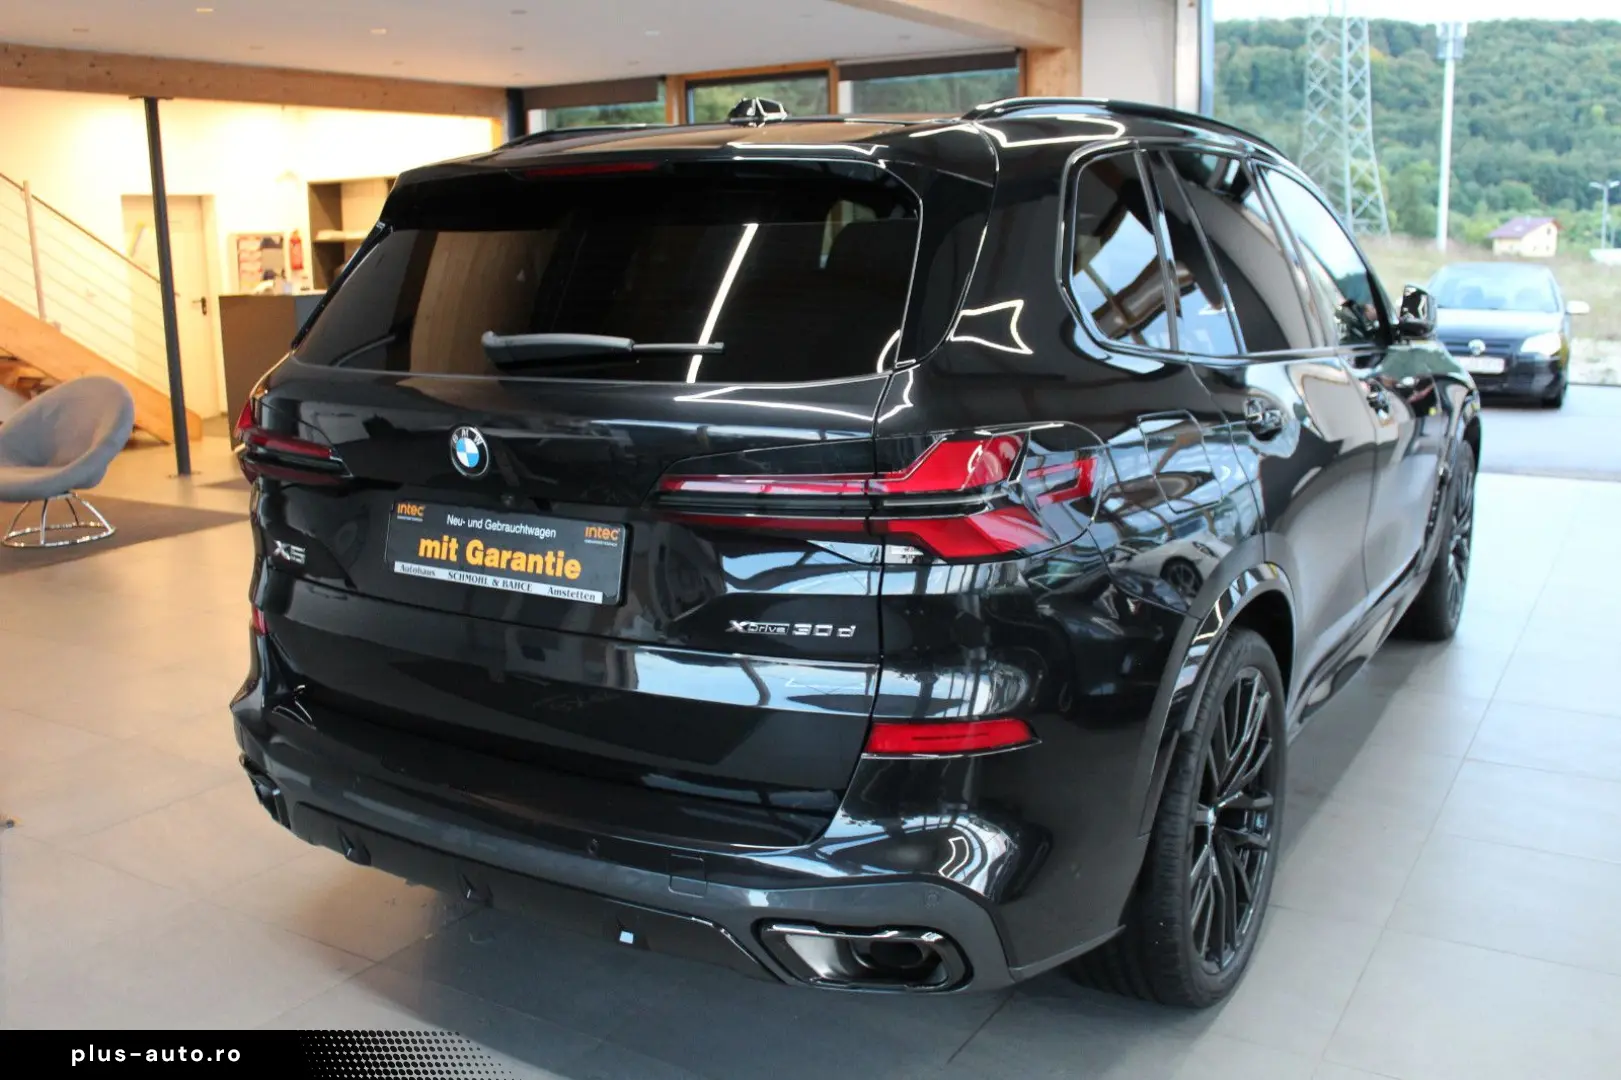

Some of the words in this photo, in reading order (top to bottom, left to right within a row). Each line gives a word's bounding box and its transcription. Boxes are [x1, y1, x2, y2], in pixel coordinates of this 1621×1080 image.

[397, 503, 424, 517] intec
[446, 514, 466, 527] Neu-
[467, 519, 483, 530] und
[484, 519, 557, 539] Gebrauchtwagen
[584, 526, 620, 541] intec
[273, 539, 306, 565] X5
[418, 535, 459, 562] mit
[465, 539, 582, 580] Garantie
[400, 564, 436, 577] Autohaus
[491, 578, 500, 587] &
[547, 586, 596, 602] Amstetten
